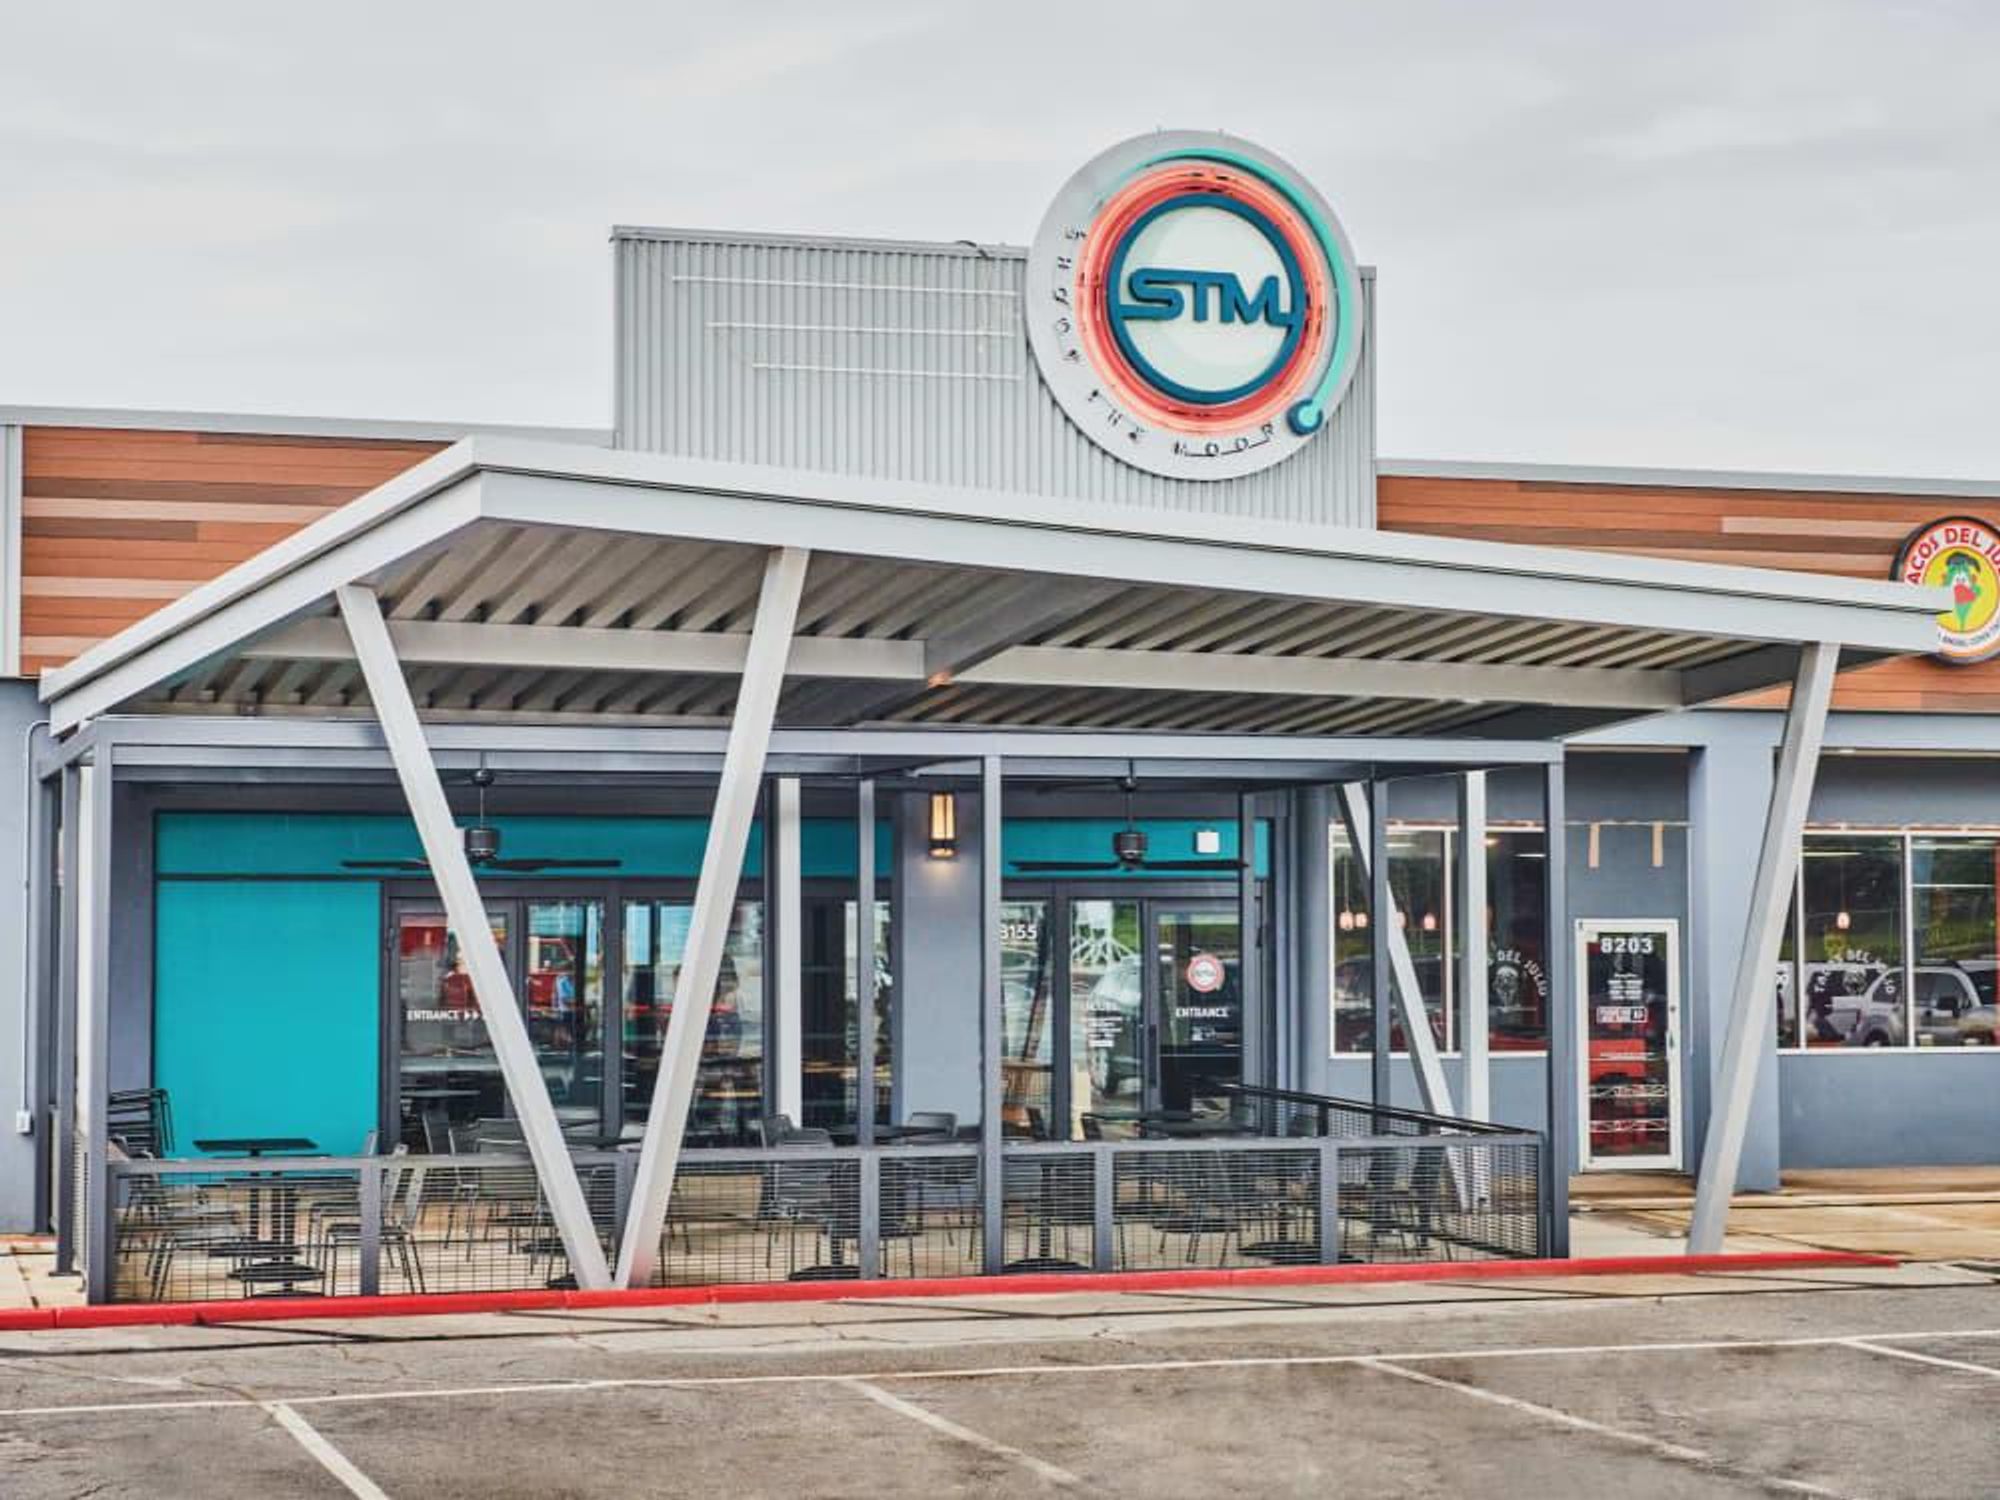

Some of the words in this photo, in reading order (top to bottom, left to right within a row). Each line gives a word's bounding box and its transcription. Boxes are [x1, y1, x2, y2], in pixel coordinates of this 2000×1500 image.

[1120, 268, 1293, 327] STM
[1906, 536, 1939, 585] ACOS
[1944, 527, 1981, 547] DEL
[1600, 936, 1653, 954] 8203
[1497, 950, 1521, 964] DEL
[406, 1009, 459, 1021] ENTRANCE
[1175, 1005, 1229, 1018] ENTRANCE
